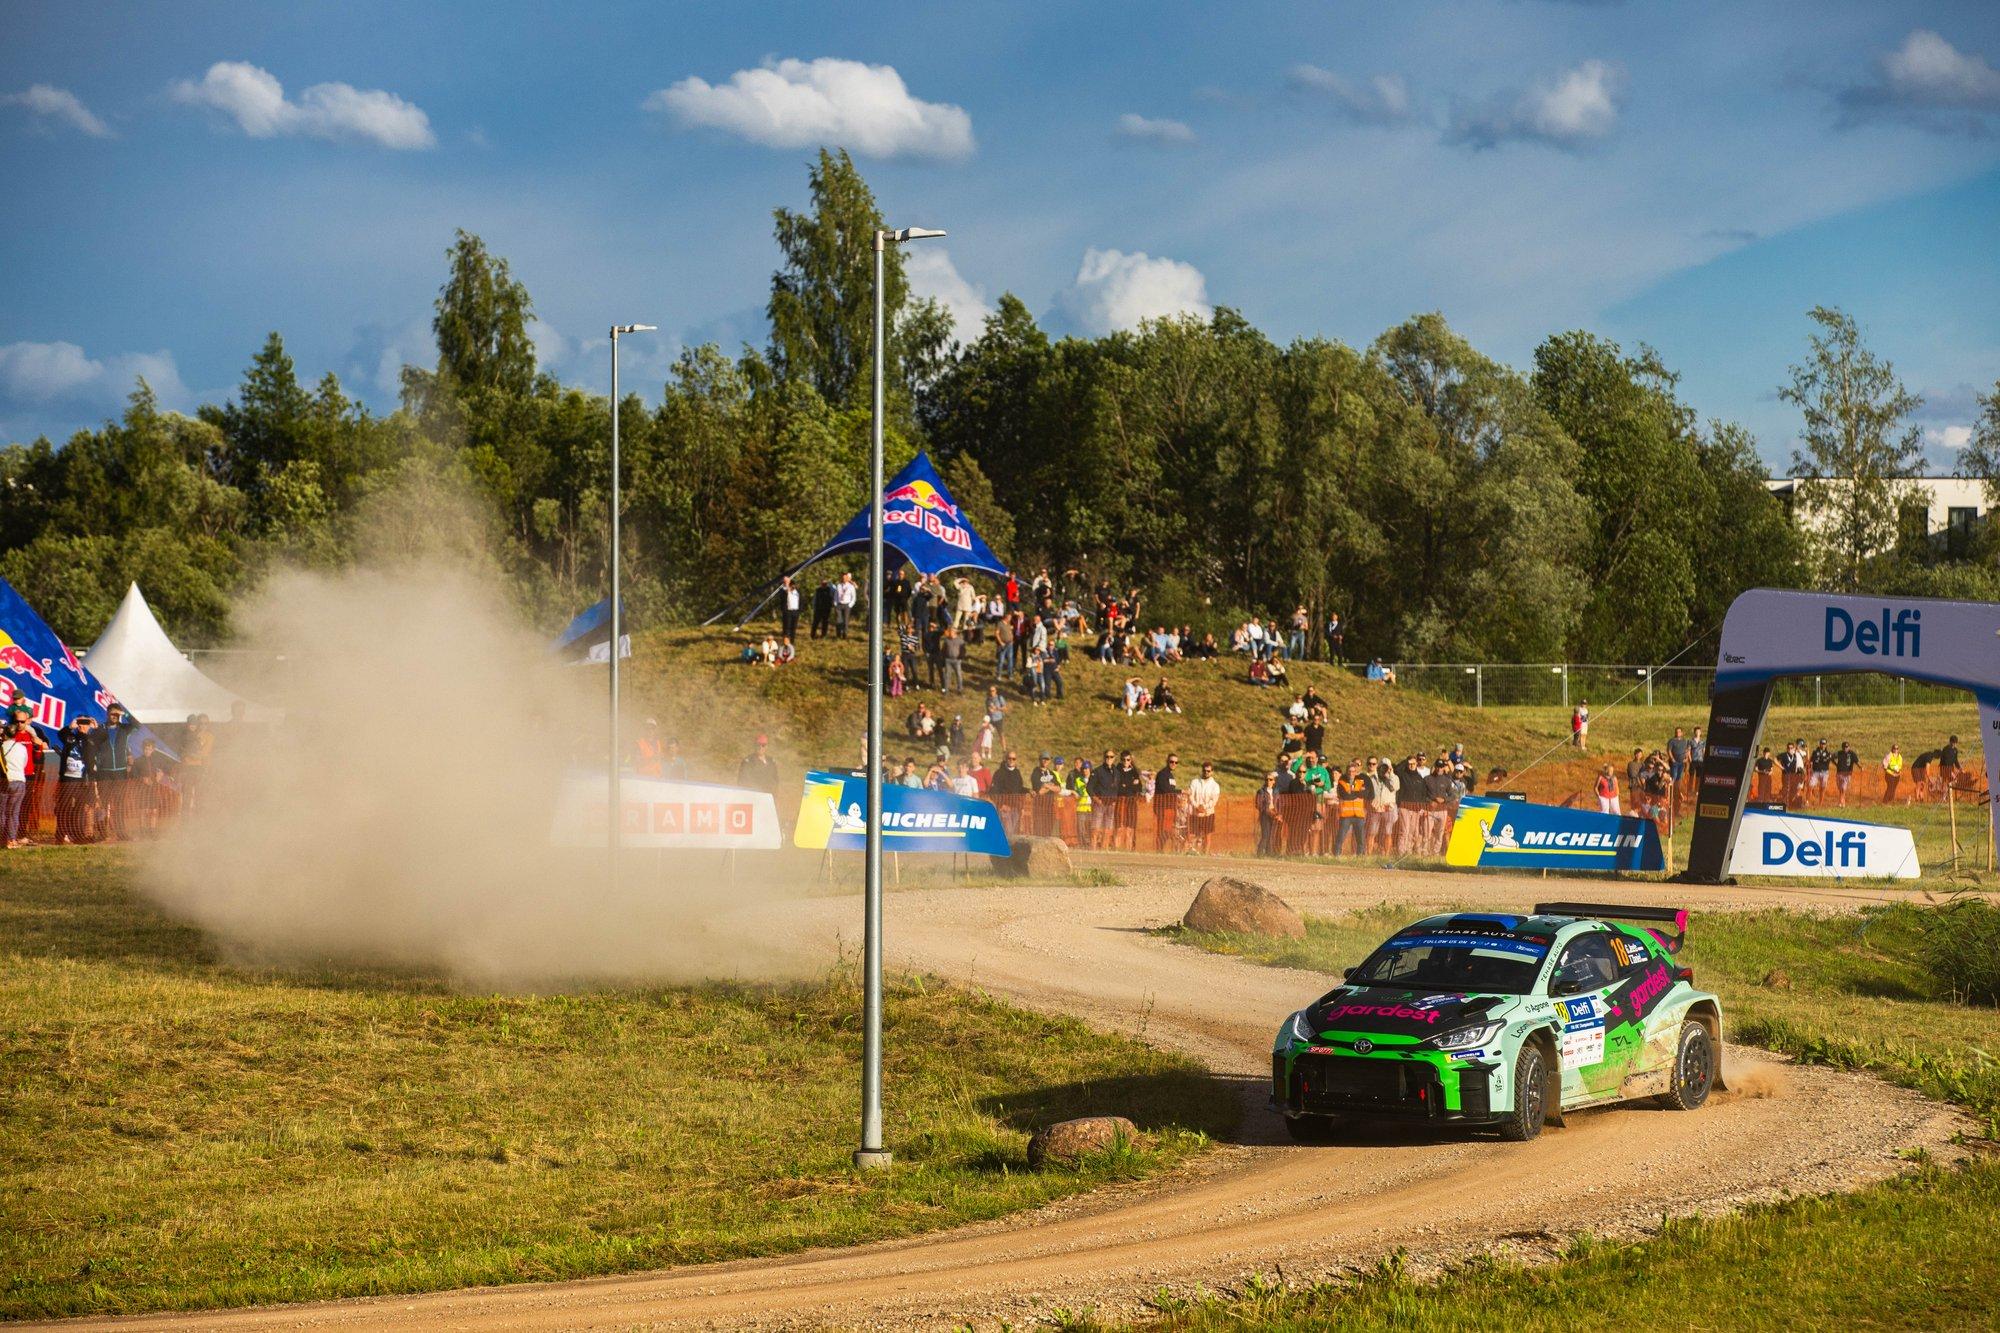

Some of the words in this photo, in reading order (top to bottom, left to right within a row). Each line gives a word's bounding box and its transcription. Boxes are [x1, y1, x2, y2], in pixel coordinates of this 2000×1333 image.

[868, 506, 923, 529] ed
[924, 512, 972, 550] Bull
[1824, 606, 1921, 658] Delfi
[1522, 831, 1644, 848] MICHELIN
[1762, 831, 1866, 867] Delfi
[1610, 937, 1630, 967] 18
[1629, 963, 1671, 1017] gardest
[1327, 1003, 1441, 1024] gardest
[1554, 1002, 1570, 1023] 18
[1571, 1001, 1591, 1017] Delfi
